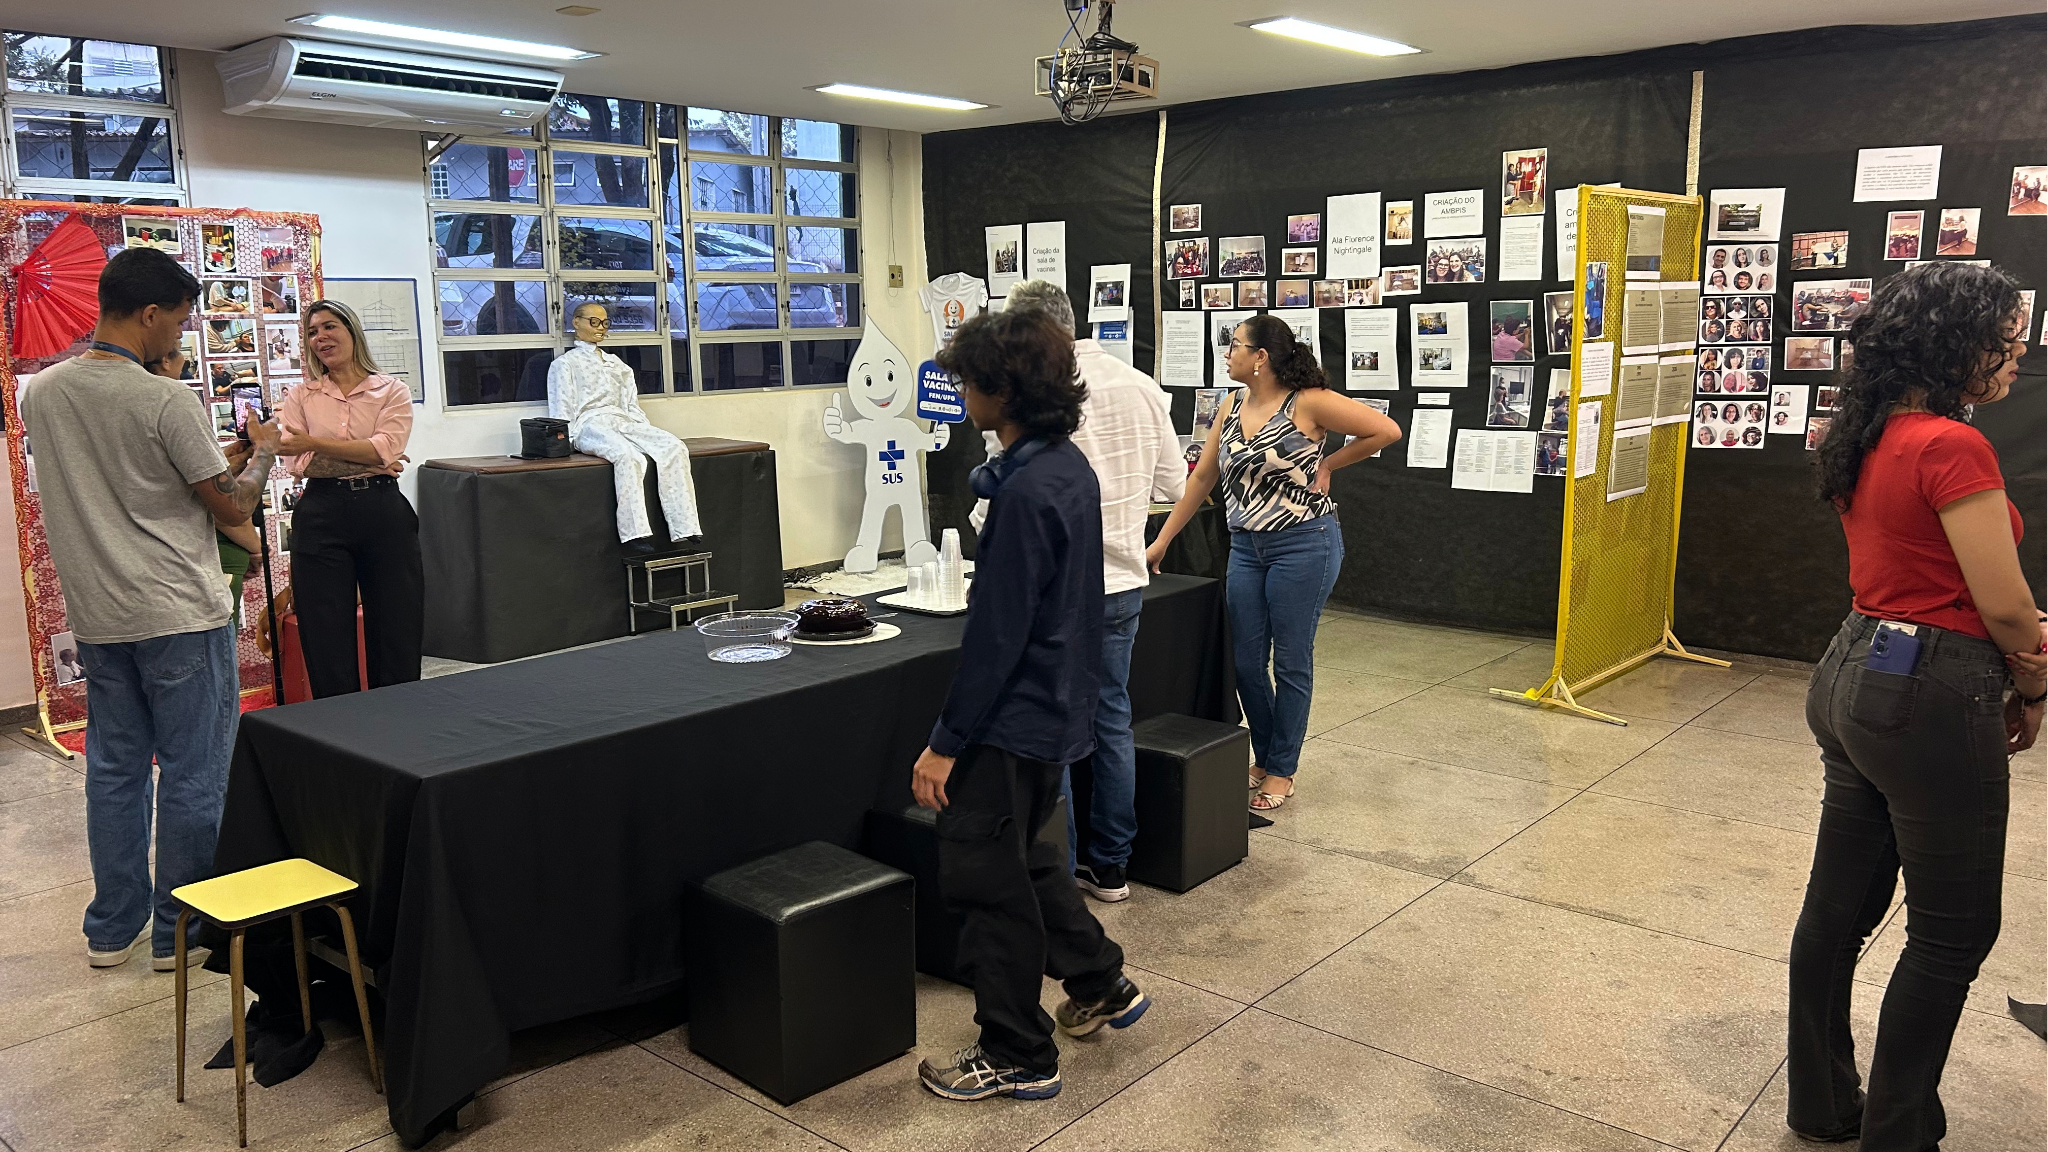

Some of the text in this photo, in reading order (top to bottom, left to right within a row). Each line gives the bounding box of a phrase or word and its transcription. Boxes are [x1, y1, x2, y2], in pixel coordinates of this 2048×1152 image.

[508, 159, 524, 170] ARE
[1432, 196, 1475, 207] CRIAÇÃO DO
[1441, 206, 1467, 215] AMBPIS
[1331, 235, 1375, 244] Ala Florence
[1566, 232, 1577, 240] de
[1032, 247, 1052, 255] Criação
[1333, 246, 1372, 257] Nightingale
[925, 371, 948, 382] SALA
[928, 392, 956, 402] FEN/UFG
[881, 472, 904, 485] SUS
